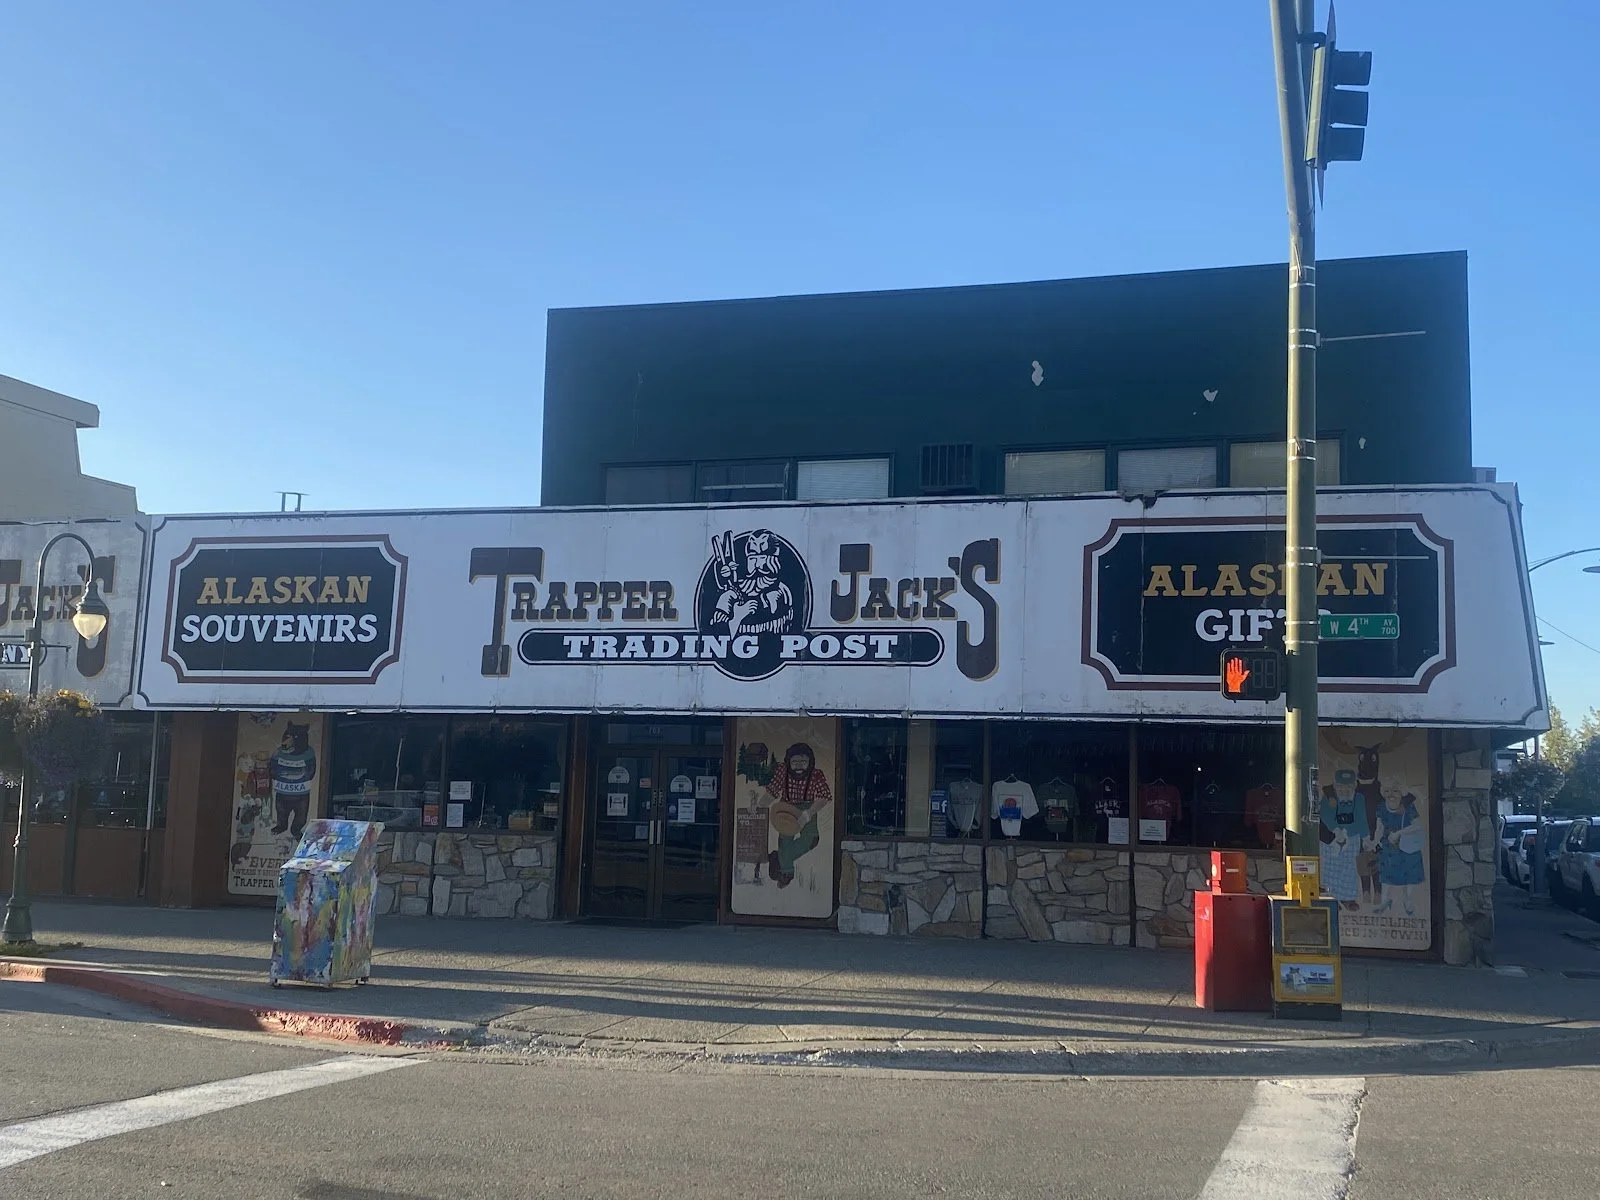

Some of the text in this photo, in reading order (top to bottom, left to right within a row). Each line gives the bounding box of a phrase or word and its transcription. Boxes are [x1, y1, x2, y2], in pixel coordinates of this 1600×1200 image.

[197, 576, 372, 604] ALASKAN
[469, 546, 679, 677] TRAPPER
[181, 614, 378, 643] SOUVENIRS
[1195, 608, 1333, 642] GIF
[1330, 621, 1339, 635] W
[1384, 619, 1393, 627] AV
[1382, 627, 1397, 635] 700
[563, 635, 898, 660] TRADING POST
[276, 782, 306, 791] ALASKA
[233, 876, 275, 888] TRAPPER
